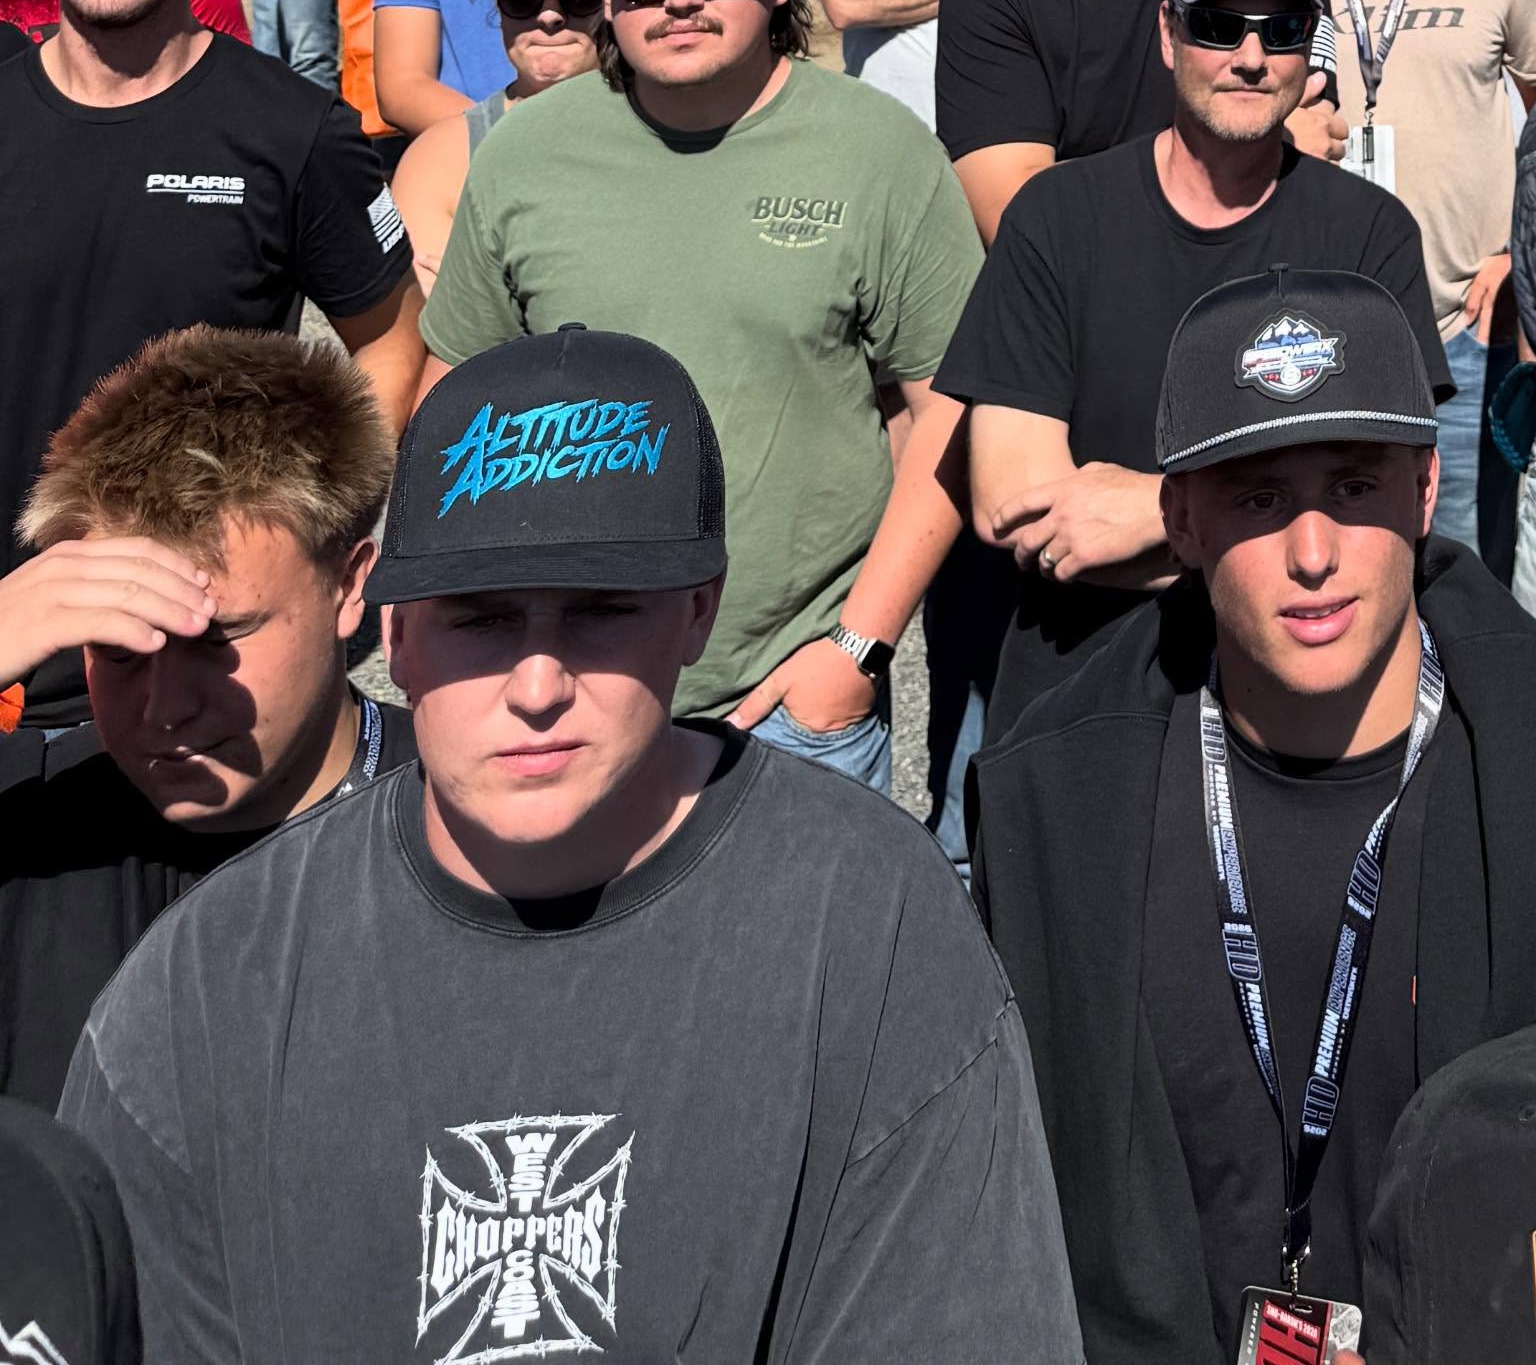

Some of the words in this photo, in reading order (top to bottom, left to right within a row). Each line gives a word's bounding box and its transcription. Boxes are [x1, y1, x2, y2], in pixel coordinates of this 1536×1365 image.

[147, 174, 245, 190] POLARIS
[187, 193, 243, 205] POWERTRAIN
[752, 196, 848, 227] BUSCH
[768, 221, 823, 236] LIGHT
[440, 398, 654, 469] ALTITUDE
[437, 422, 671, 519] ADDICTION
[1214, 764, 1234, 829] PREMIUM
[1220, 828, 1247, 914] EXPERIENCE
[1347, 849, 1381, 915] HD
[1222, 929, 1262, 981] HD
[1246, 982, 1270, 1050] PREMIUM
[1327, 924, 1356, 1014] EXPERIENCE
[1315, 1008, 1340, 1077] PREMIUM
[1302, 1076, 1340, 1129] HD
[505, 1133, 557, 1212] WEST
[430, 1184, 607, 1299] CHOPPERS
[491, 1249, 541, 1339] COAST
